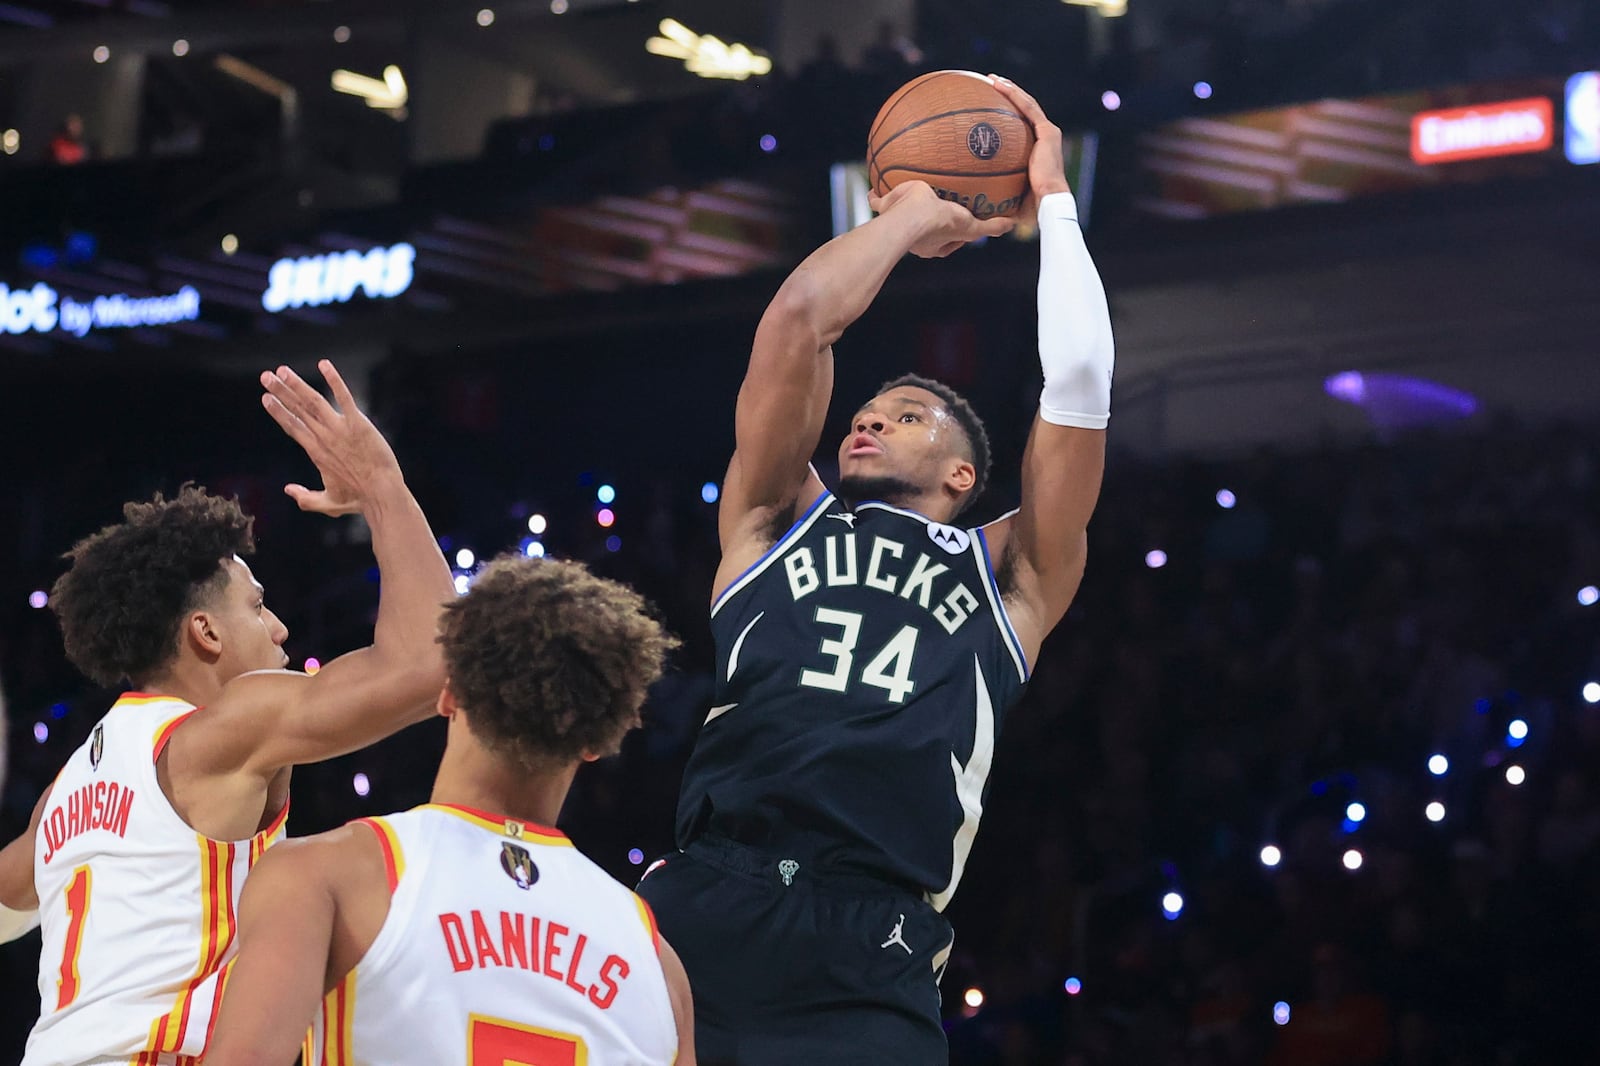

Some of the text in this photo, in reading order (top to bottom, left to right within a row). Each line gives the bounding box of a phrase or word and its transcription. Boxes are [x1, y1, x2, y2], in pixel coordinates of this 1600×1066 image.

[783, 533, 980, 635] BUCKS
[799, 606, 920, 704] 34
[43, 780, 135, 865] JOHNSON
[55, 863, 92, 1012] 1
[438, 909, 631, 1010] DANIELS
